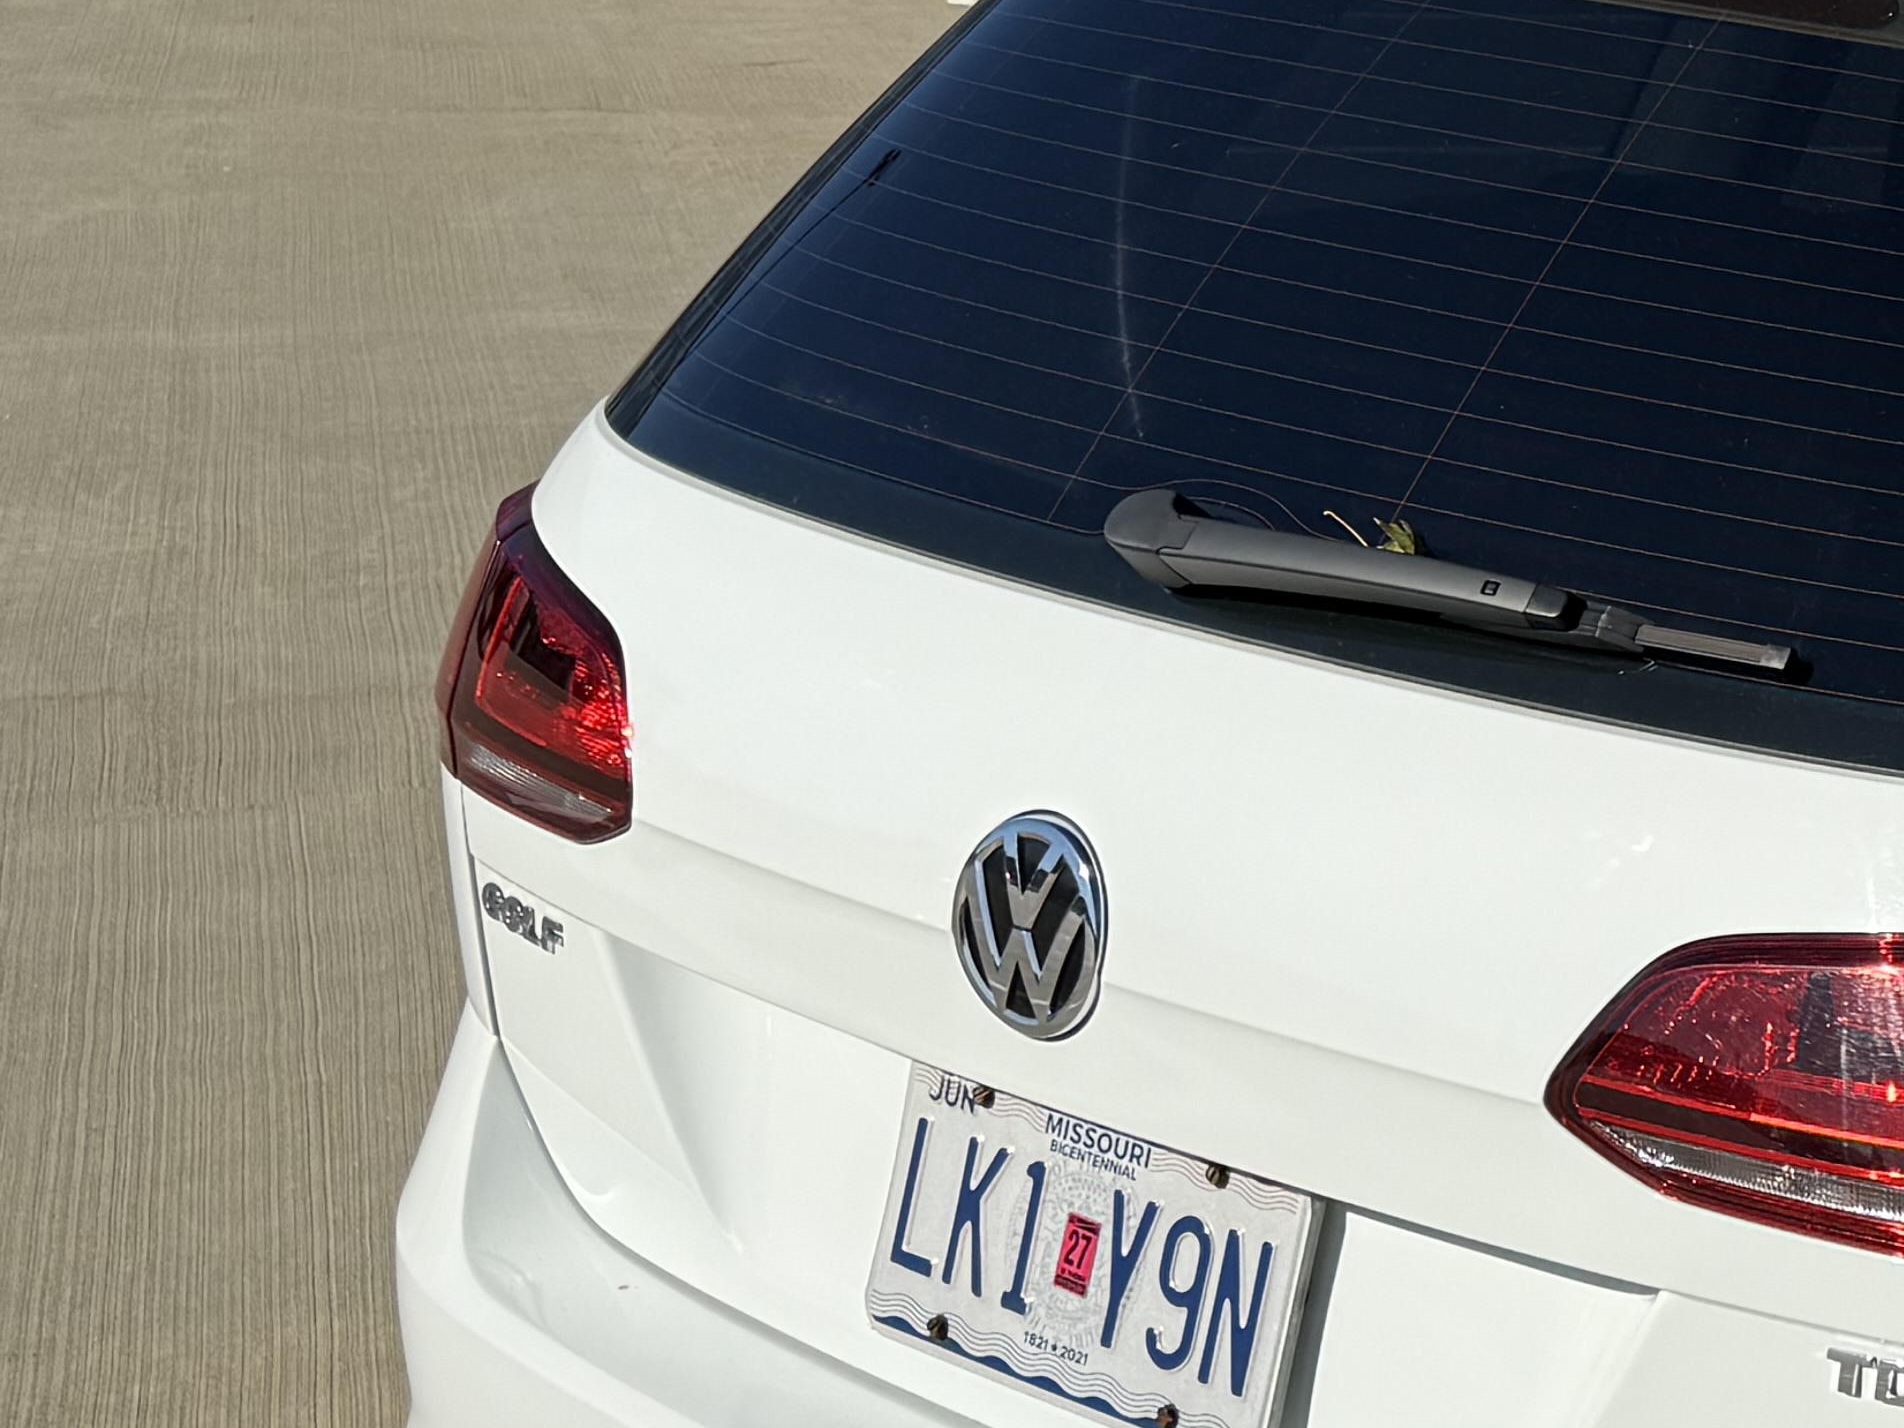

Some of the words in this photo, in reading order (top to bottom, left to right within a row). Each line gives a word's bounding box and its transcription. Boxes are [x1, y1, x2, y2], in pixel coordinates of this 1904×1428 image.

[953, 818, 1100, 1040] VW
[929, 1075, 976, 1113] JUN
[1045, 1113, 1151, 1168] MISSOURI
[1050, 1140, 1137, 1181] BICENTENNIAL
[1063, 1229, 1093, 1270] 27
[1024, 1331, 1049, 1351] 1821
[1060, 1345, 1089, 1366] 2021
